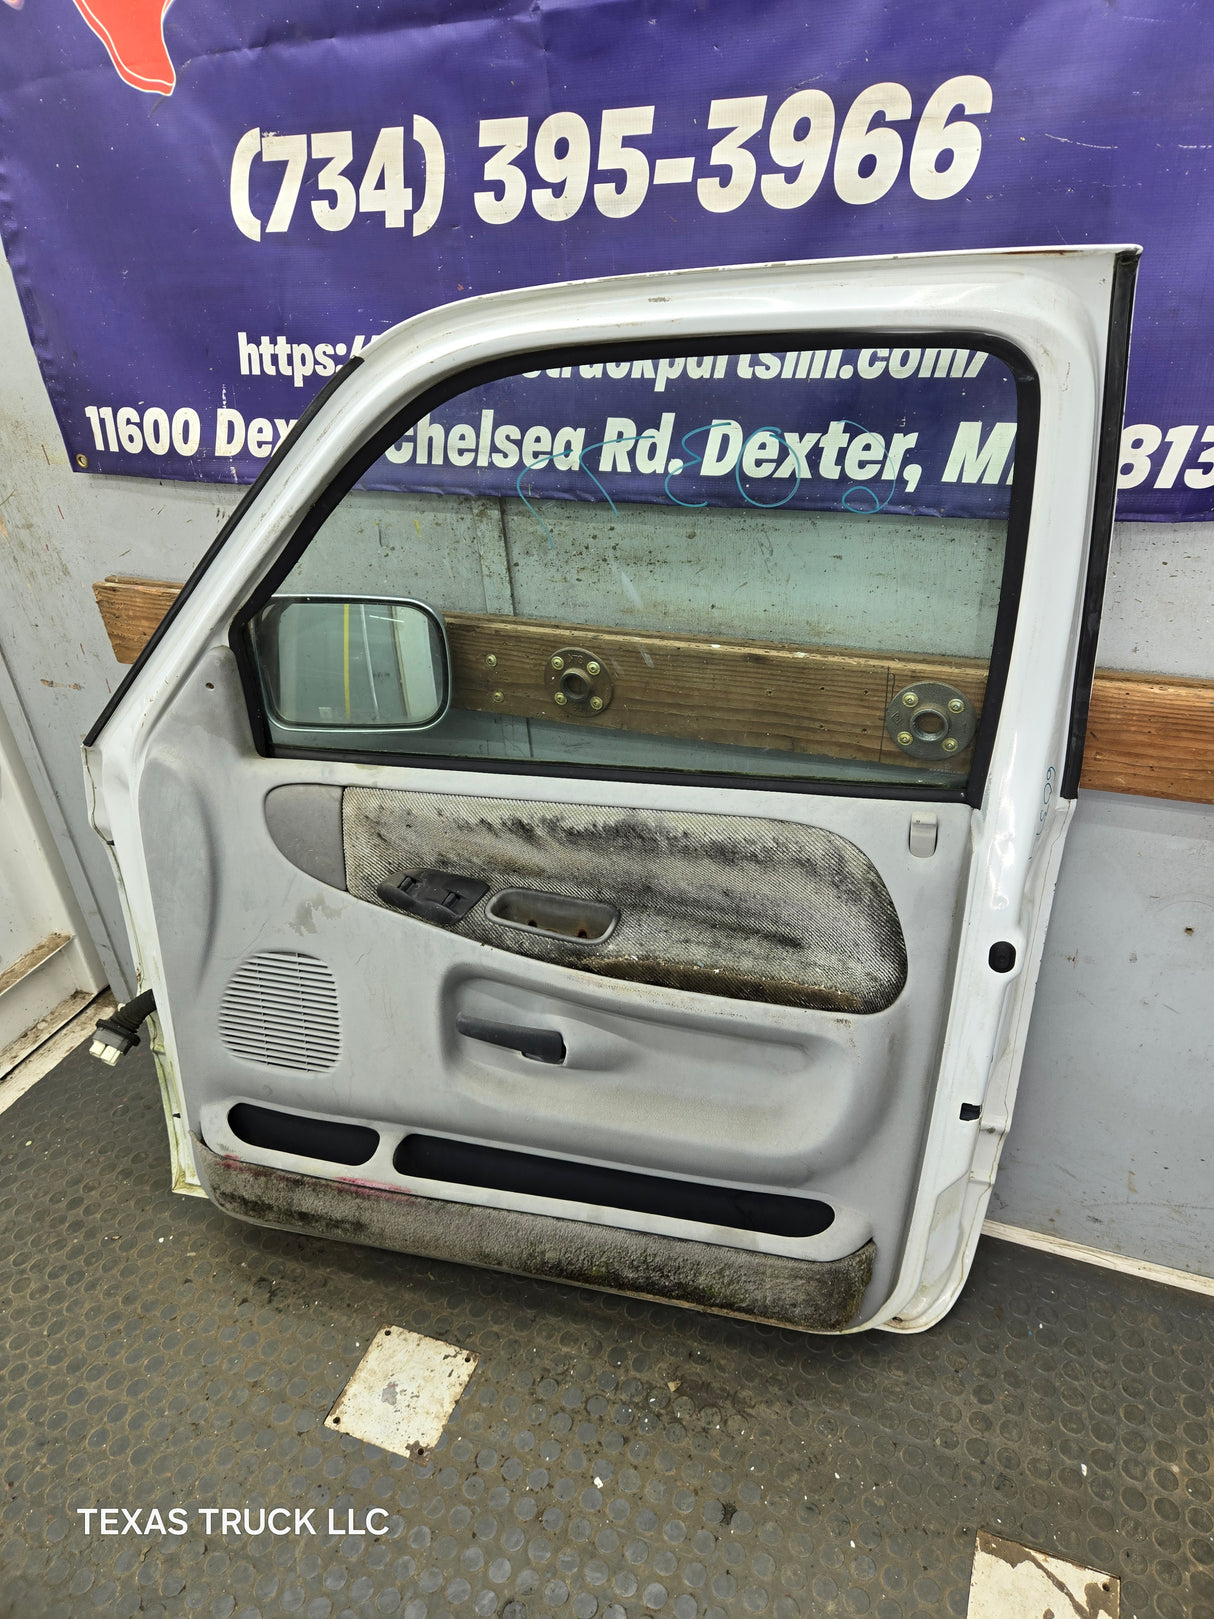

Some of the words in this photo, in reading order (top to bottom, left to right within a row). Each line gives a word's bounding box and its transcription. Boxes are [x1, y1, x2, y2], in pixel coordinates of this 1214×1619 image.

[229, 113, 446, 242] (734)
[474, 75, 993, 225] 395-3966
[85, 406, 200, 457] 11600
[598, 412, 684, 475] Rd.
[700, 419, 922, 493] Dexter,
